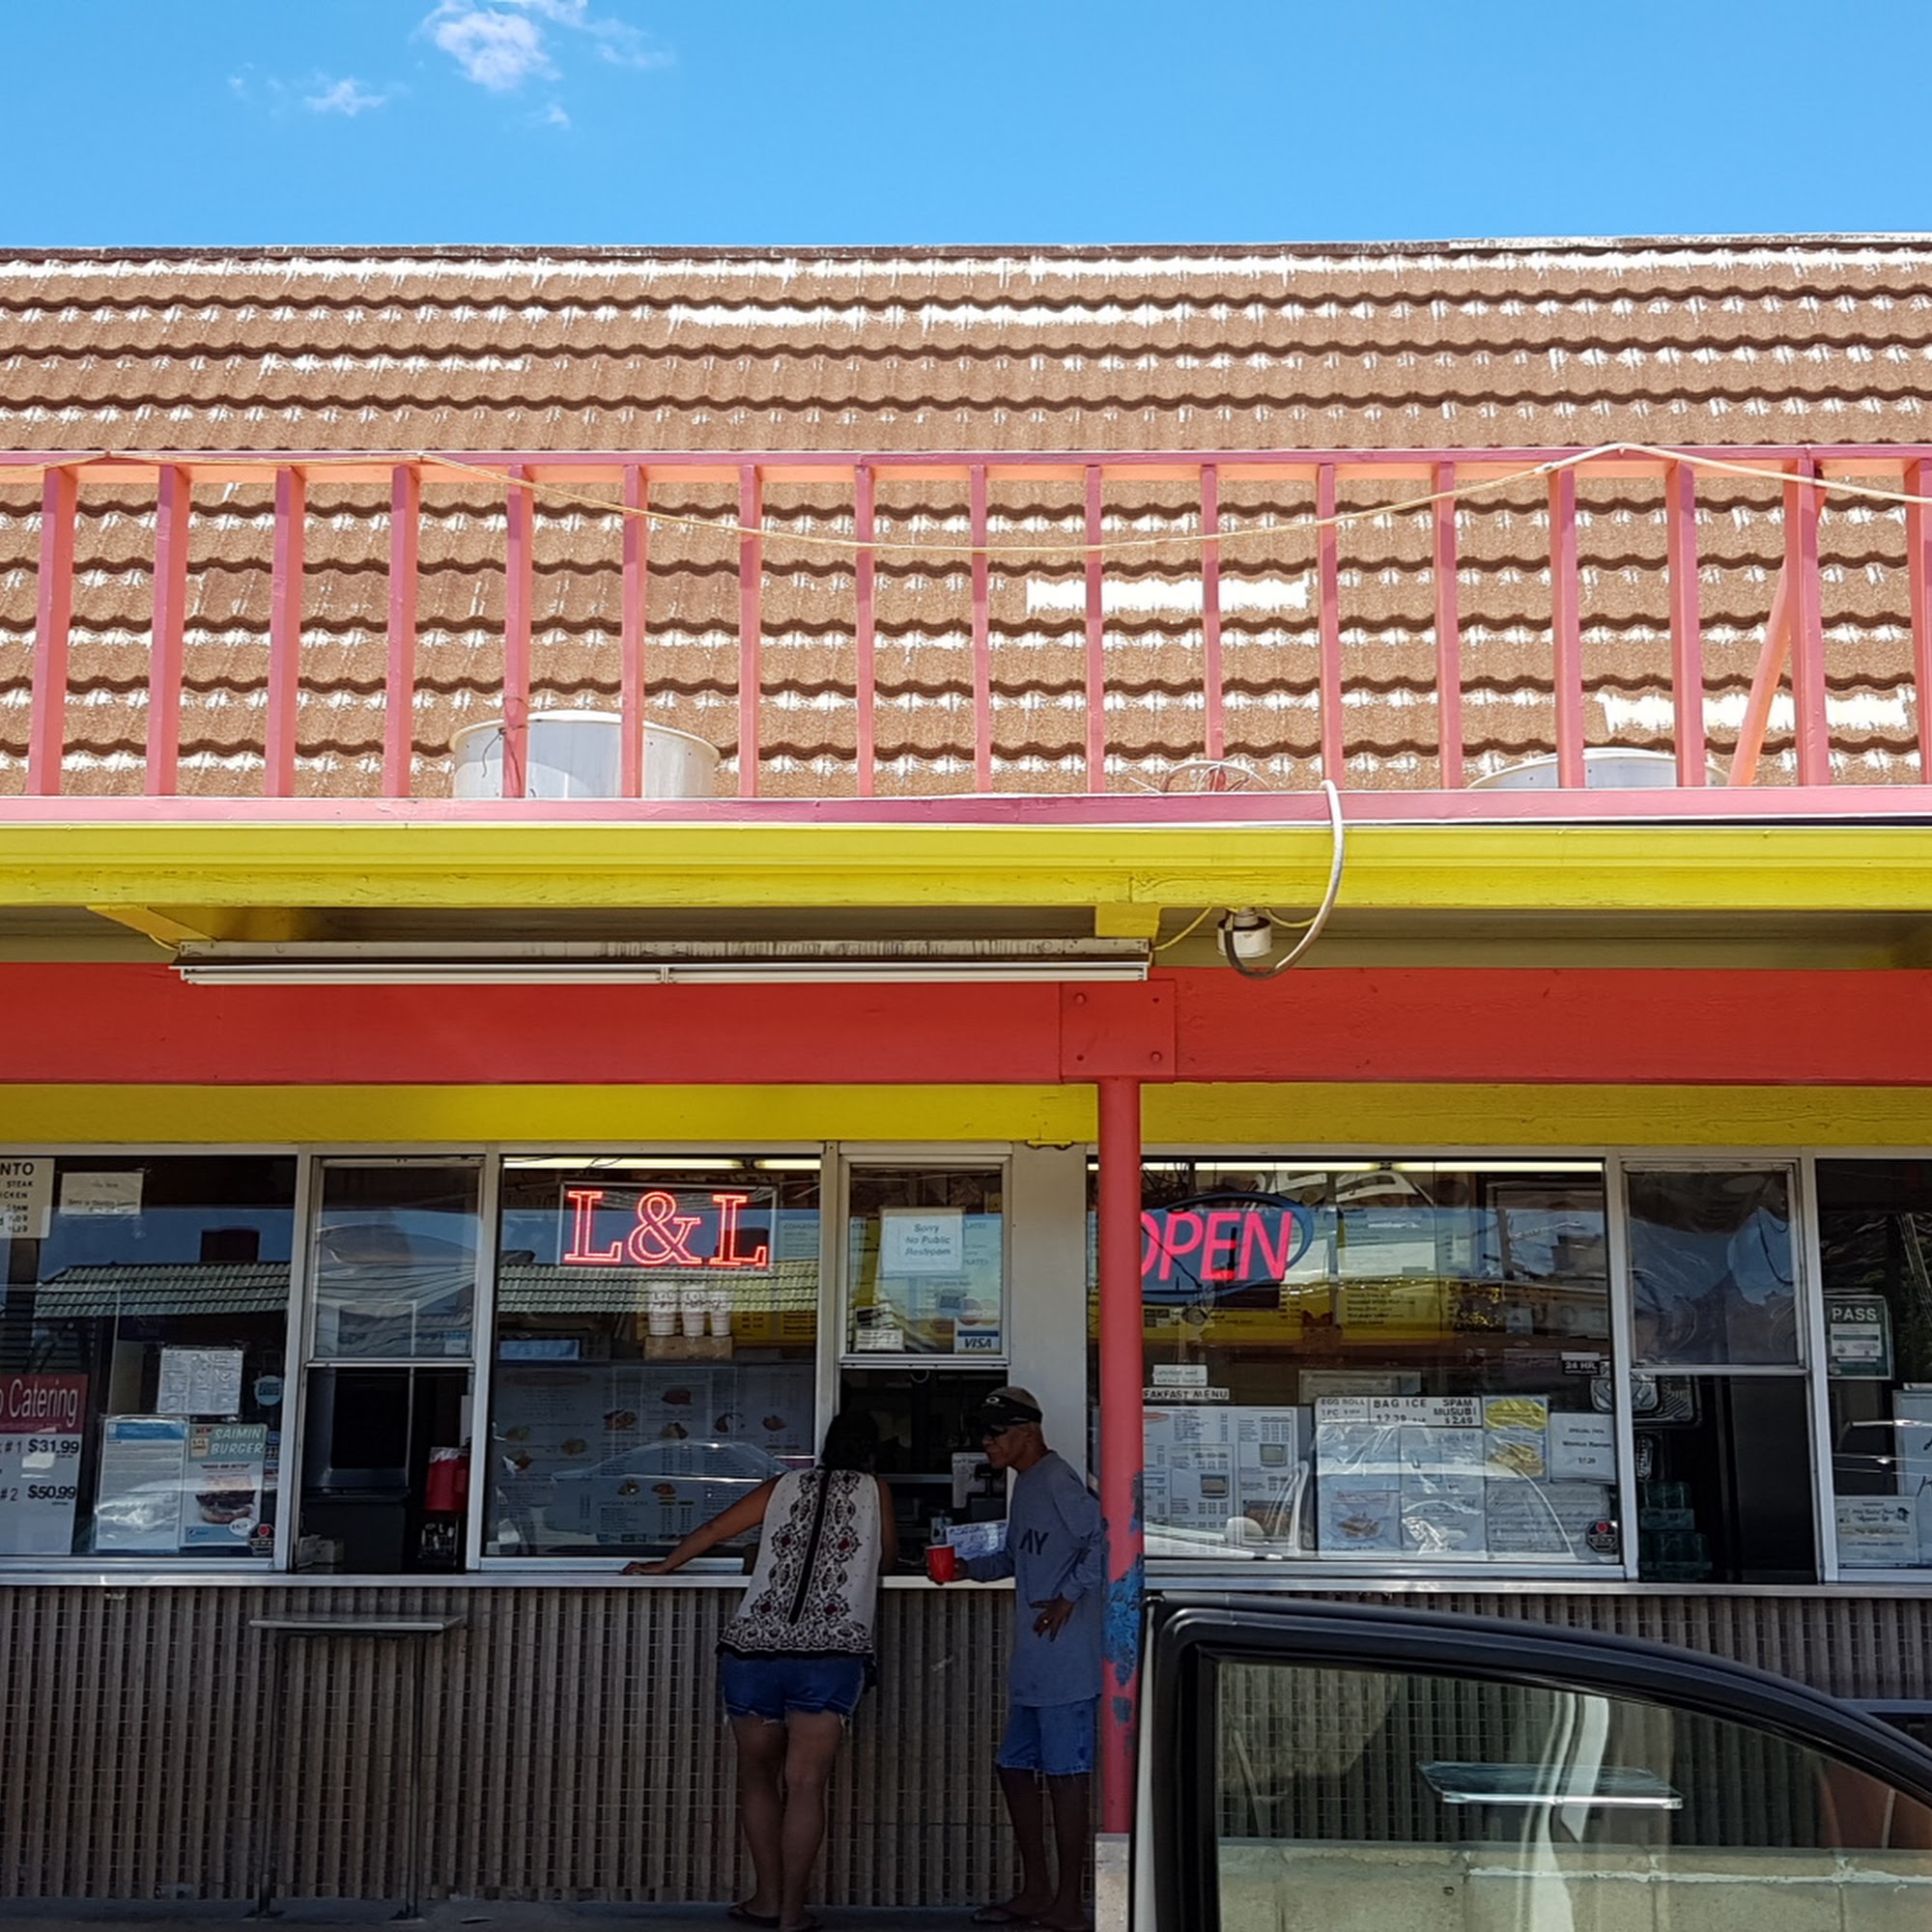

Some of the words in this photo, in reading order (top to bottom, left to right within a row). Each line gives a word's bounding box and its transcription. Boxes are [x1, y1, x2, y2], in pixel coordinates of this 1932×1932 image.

[564, 1190, 768, 1267] L&L
[914, 1223, 940, 1233] Sorry
[921, 1236, 952, 1244] Public
[905, 1247, 952, 1256] Restroom
[1832, 1308, 1877, 1321] PASS
[964, 1338, 992, 1349] VISA
[1192, 1389, 1228, 1399] MENU
[9, 1378, 78, 1428] Catering
[1373, 1399, 1399, 1408] BAG
[1406, 1399, 1427, 1407] ICE
[1434, 1407, 1477, 1416] MUSUBI
[214, 1428, 262, 1440] SAIMIN
[28, 1438, 79, 1454] $31.99
[211, 1442, 264, 1455] BURGER
[27, 1485, 76, 1499] $50.99
